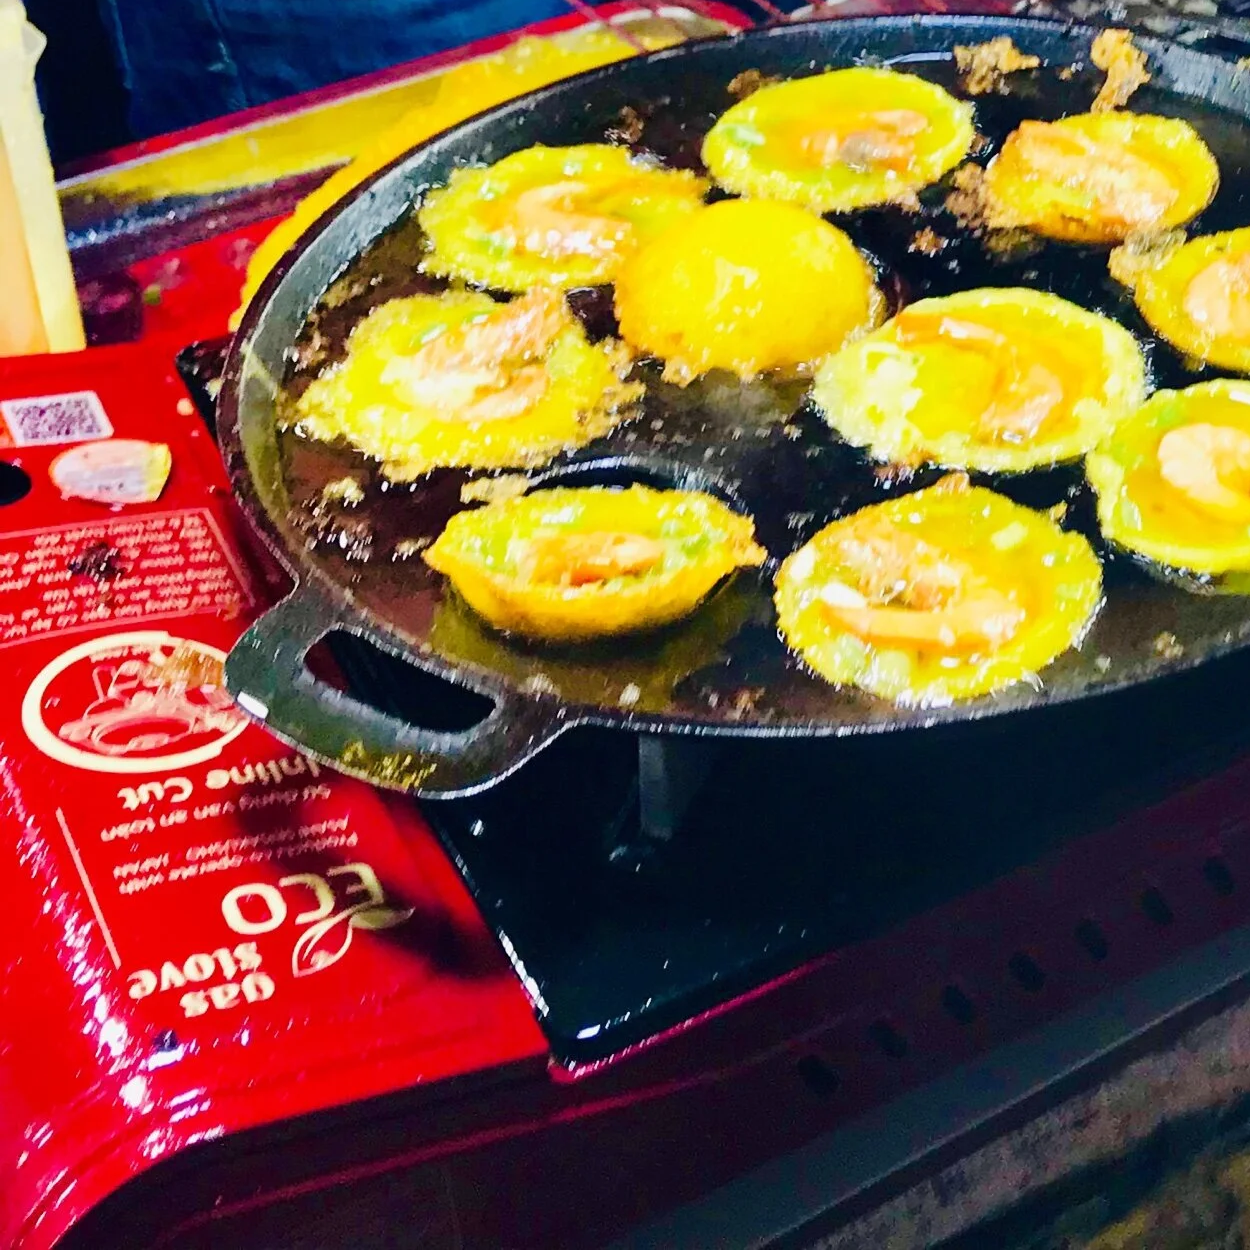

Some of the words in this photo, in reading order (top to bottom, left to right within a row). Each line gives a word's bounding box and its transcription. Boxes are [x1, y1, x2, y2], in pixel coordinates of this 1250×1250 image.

[116, 776, 194, 811] Cut
[220, 861, 385, 936] ECO
[126, 941, 263, 1000] stove
[179, 971, 276, 1018] gas
